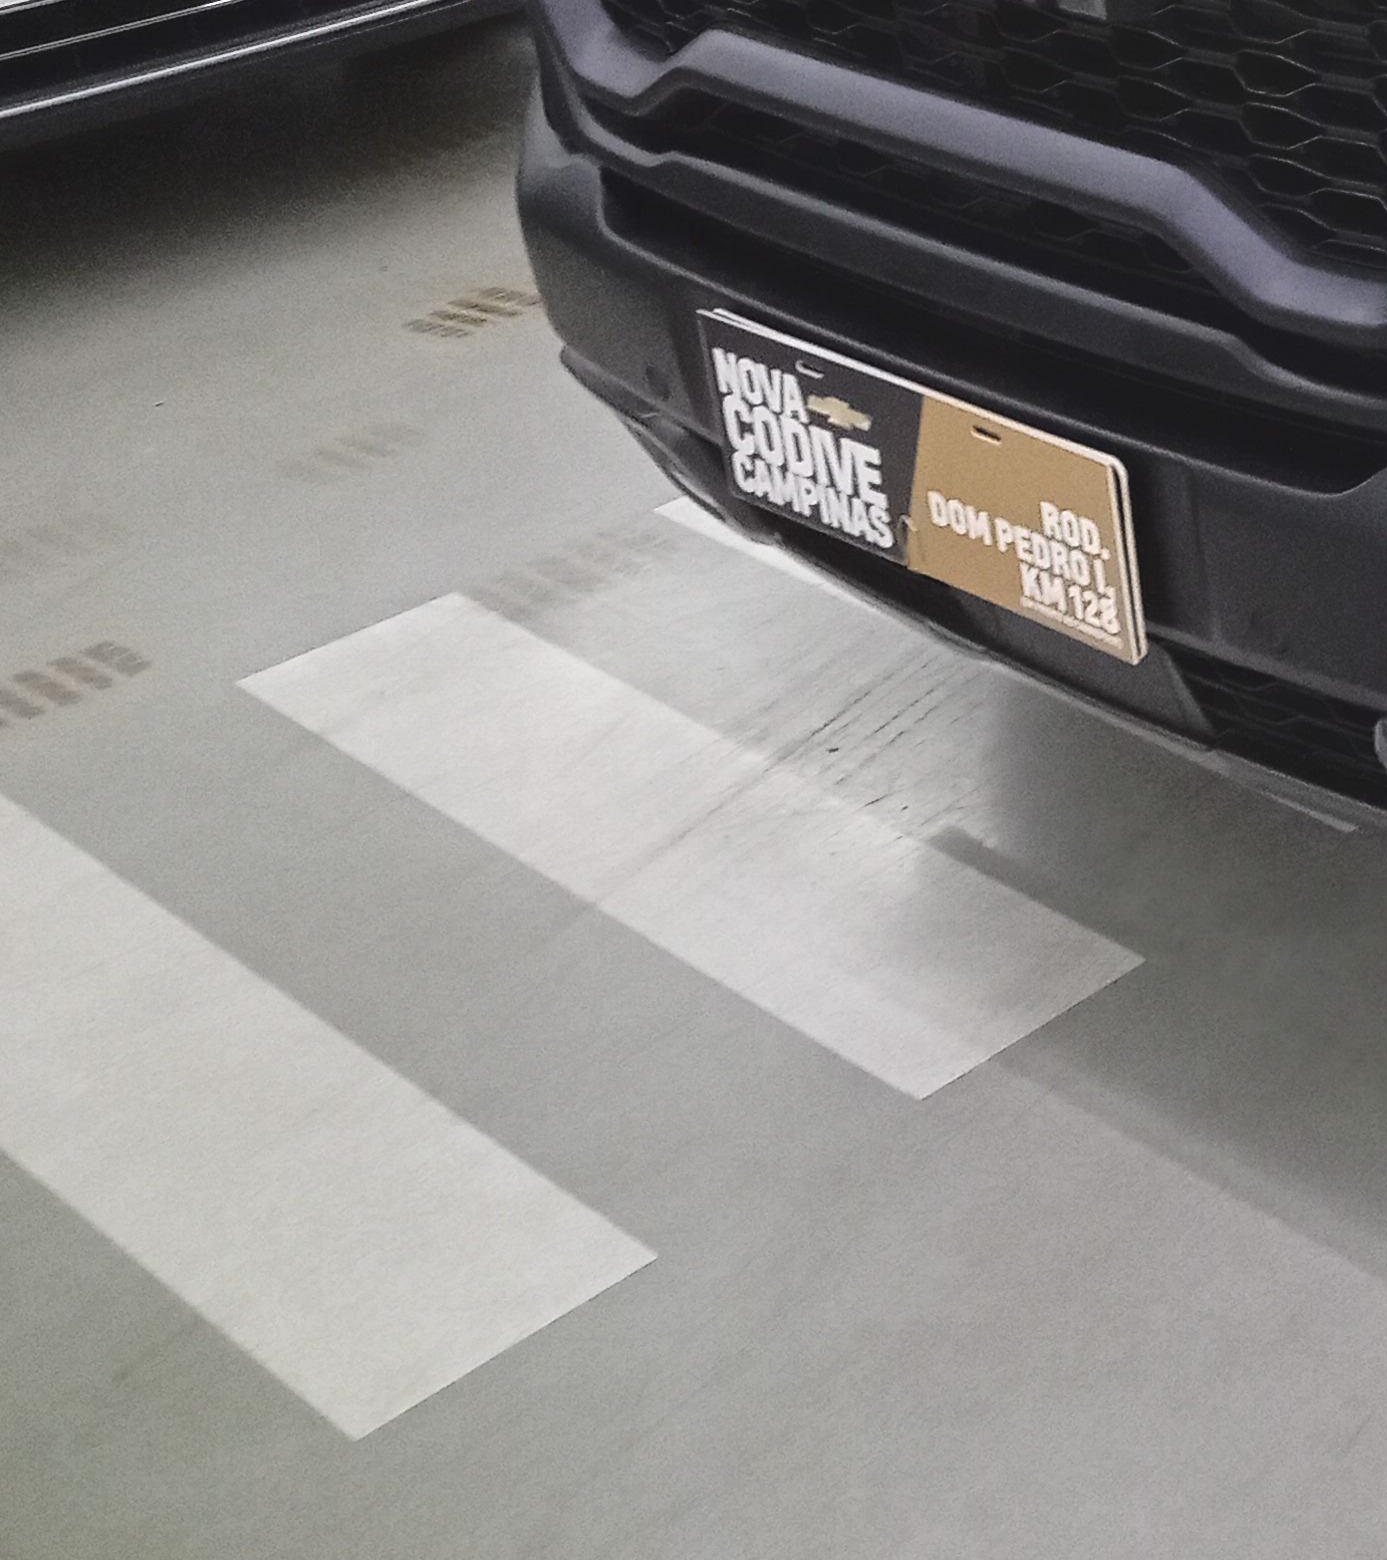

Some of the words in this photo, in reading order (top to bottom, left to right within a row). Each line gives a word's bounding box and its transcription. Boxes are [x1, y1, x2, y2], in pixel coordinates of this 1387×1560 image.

[712, 347, 810, 424] NOVA
[722, 392, 888, 511] CODIVE
[731, 450, 894, 549] CAMPINAS
[927, 490, 992, 546] DOM
[994, 517, 1090, 587] PEDRO
[1040, 501, 1111, 560] ROD.
[1019, 563, 1066, 615] KM
[1068, 585, 1121, 635] 128
